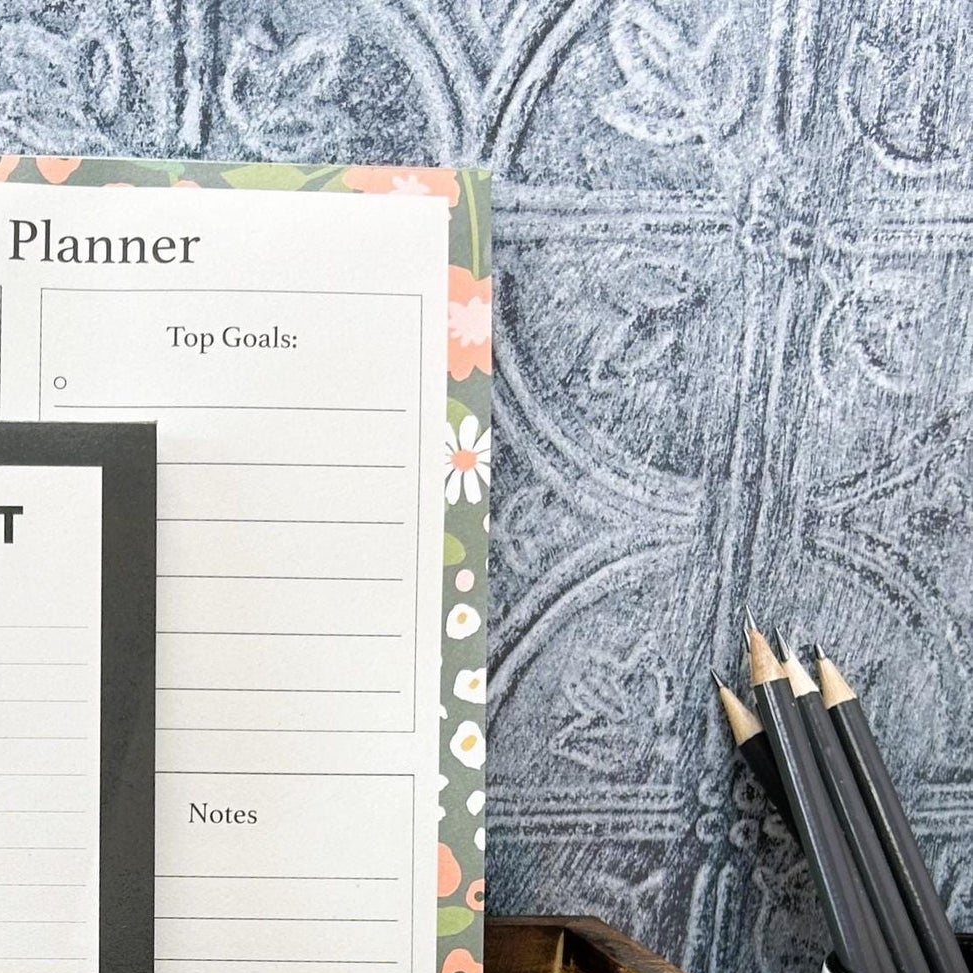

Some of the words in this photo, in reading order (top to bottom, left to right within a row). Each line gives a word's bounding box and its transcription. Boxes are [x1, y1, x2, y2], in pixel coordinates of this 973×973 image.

[9, 219, 201, 267] Planner
[167, 326, 214, 354] Top
[222, 326, 299, 351] Goals:
[188, 802, 258, 825] Notes
